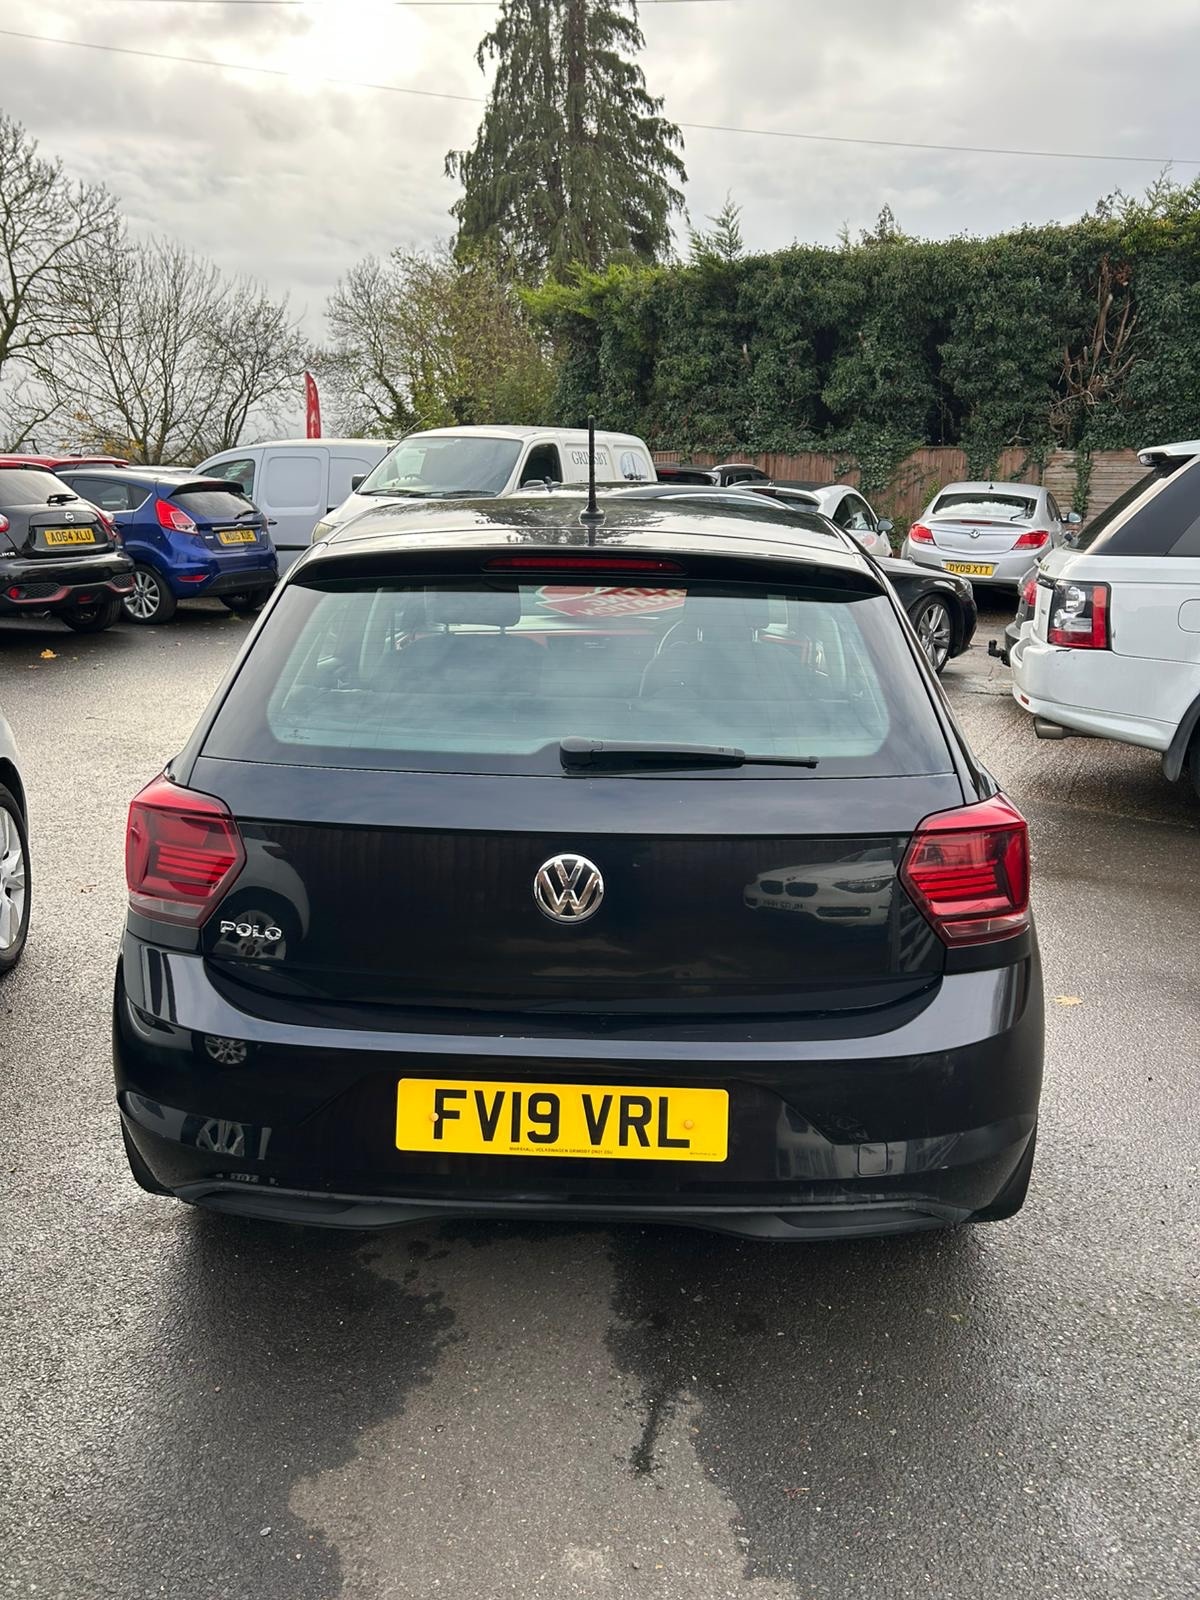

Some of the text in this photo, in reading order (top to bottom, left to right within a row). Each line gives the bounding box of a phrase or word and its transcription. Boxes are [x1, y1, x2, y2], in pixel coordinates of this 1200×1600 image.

[75, 530, 91, 541] XLU
[973, 565, 990, 575] XTT
[220, 920, 282, 940] POLO
[433, 1088, 691, 1149] FV19 VRL
